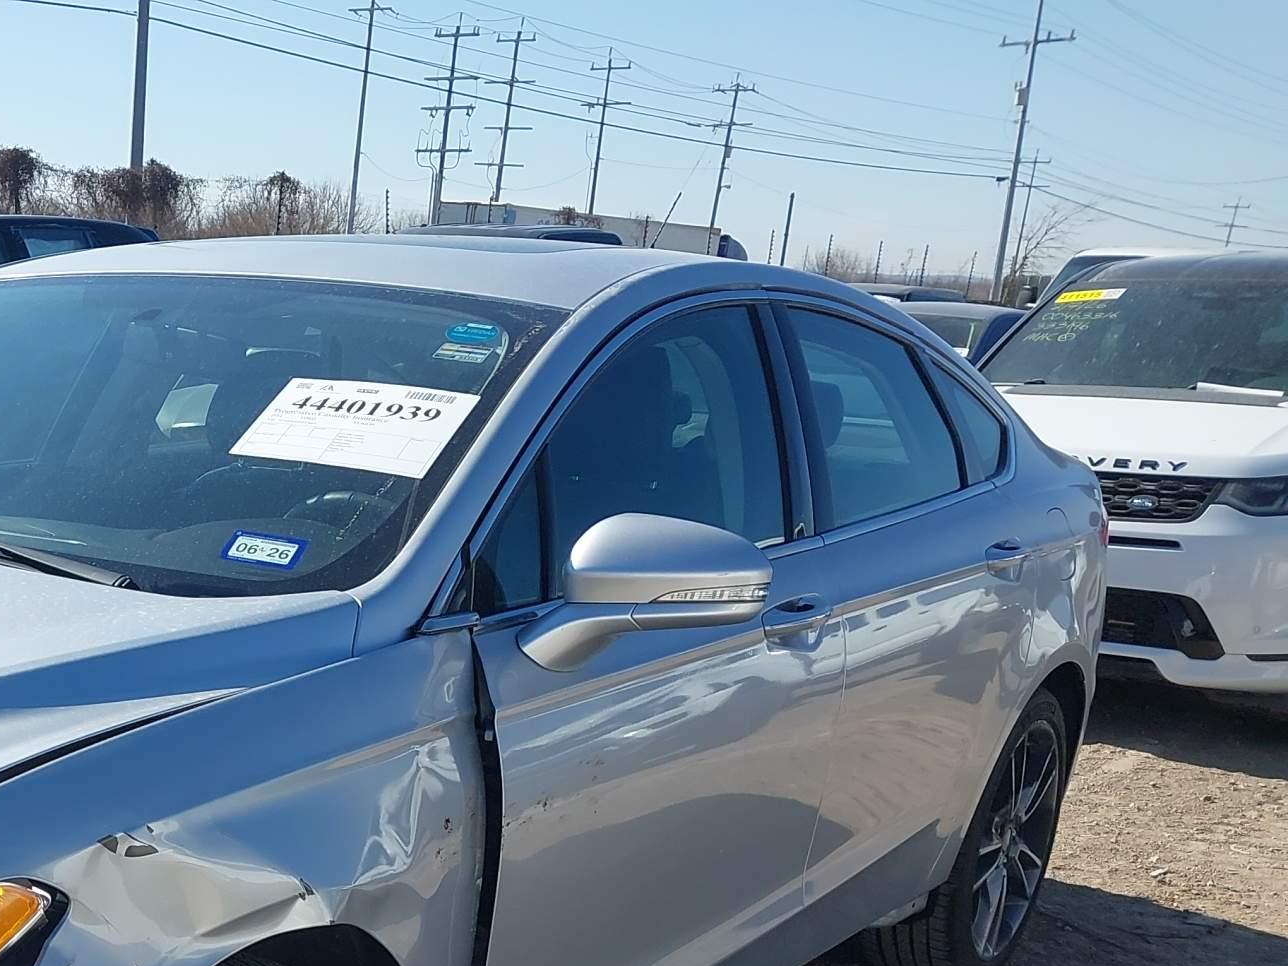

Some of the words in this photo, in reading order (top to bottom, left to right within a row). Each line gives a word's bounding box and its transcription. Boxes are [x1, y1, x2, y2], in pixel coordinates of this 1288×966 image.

[292, 396, 442, 422] 44401939
[1073, 455, 1188, 471] VERY
[235, 542, 260, 554] 06
[266, 547, 292, 560] 26
